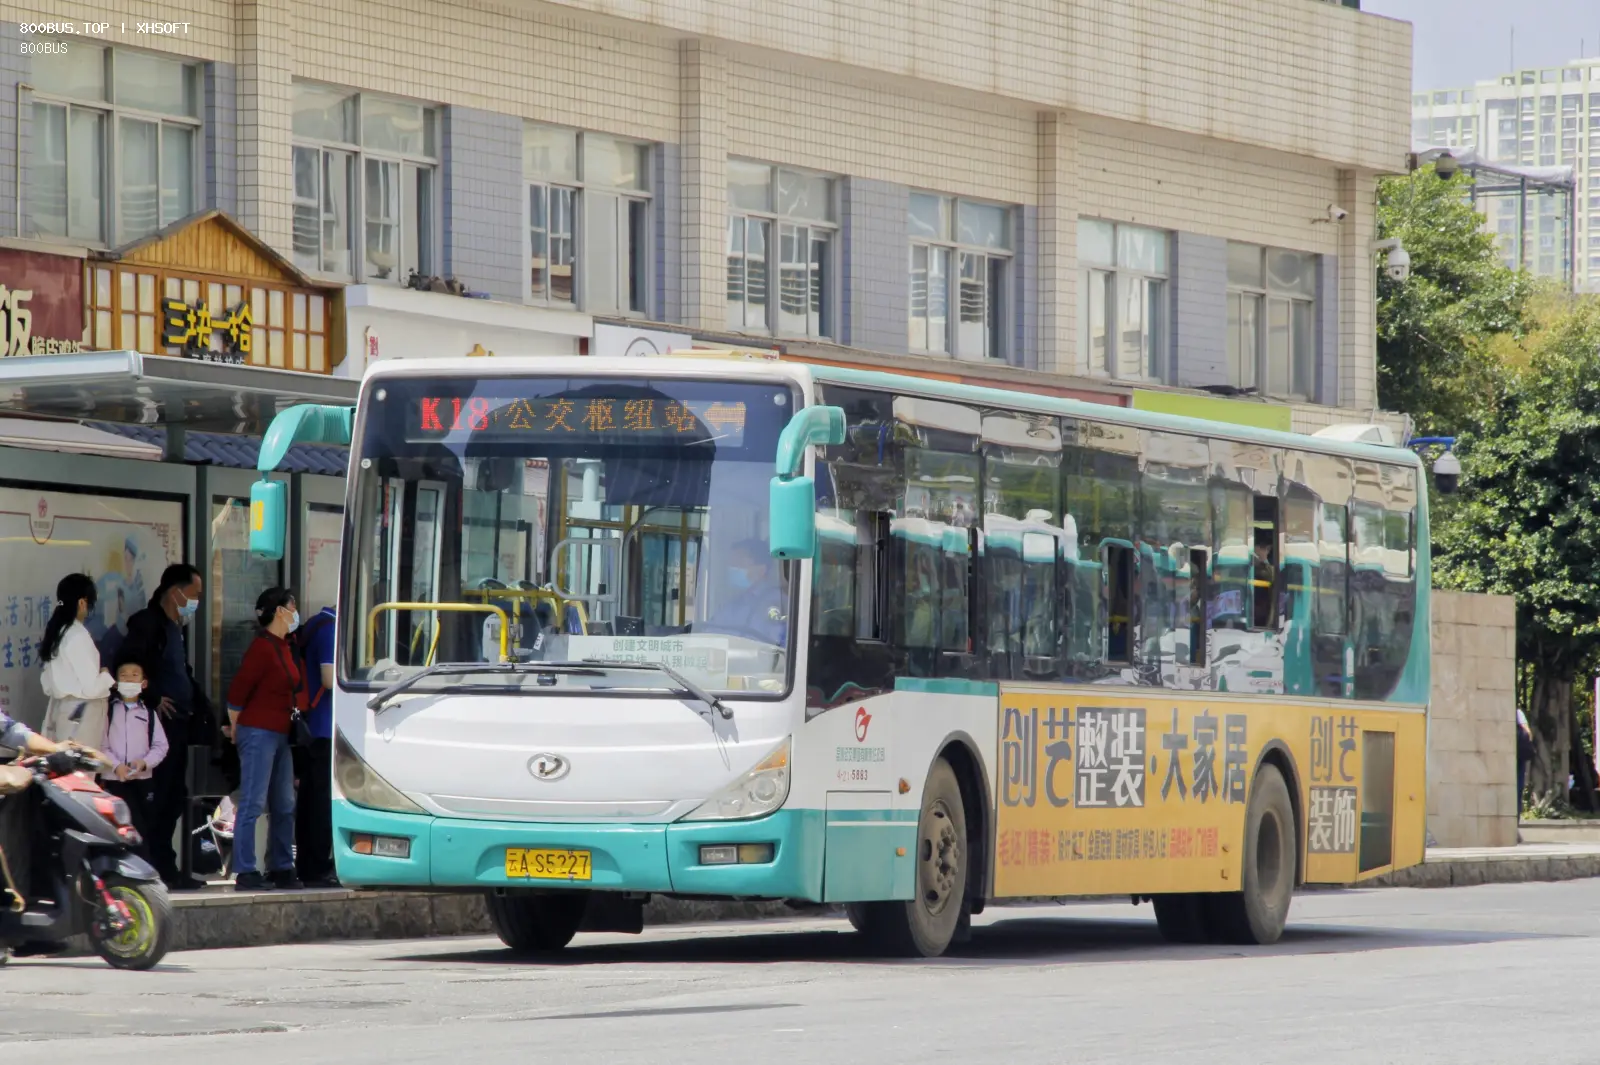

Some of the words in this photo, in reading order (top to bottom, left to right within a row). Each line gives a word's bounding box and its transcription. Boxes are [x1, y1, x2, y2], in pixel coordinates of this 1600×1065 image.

[421, 396, 489, 431] K18
[505, 397, 697, 432] 公交枢纽站
[613, 639, 684, 652] 创建文明城市
[1310, 716, 1359, 783] 创艺
[1310, 788, 1357, 852] 装饰
